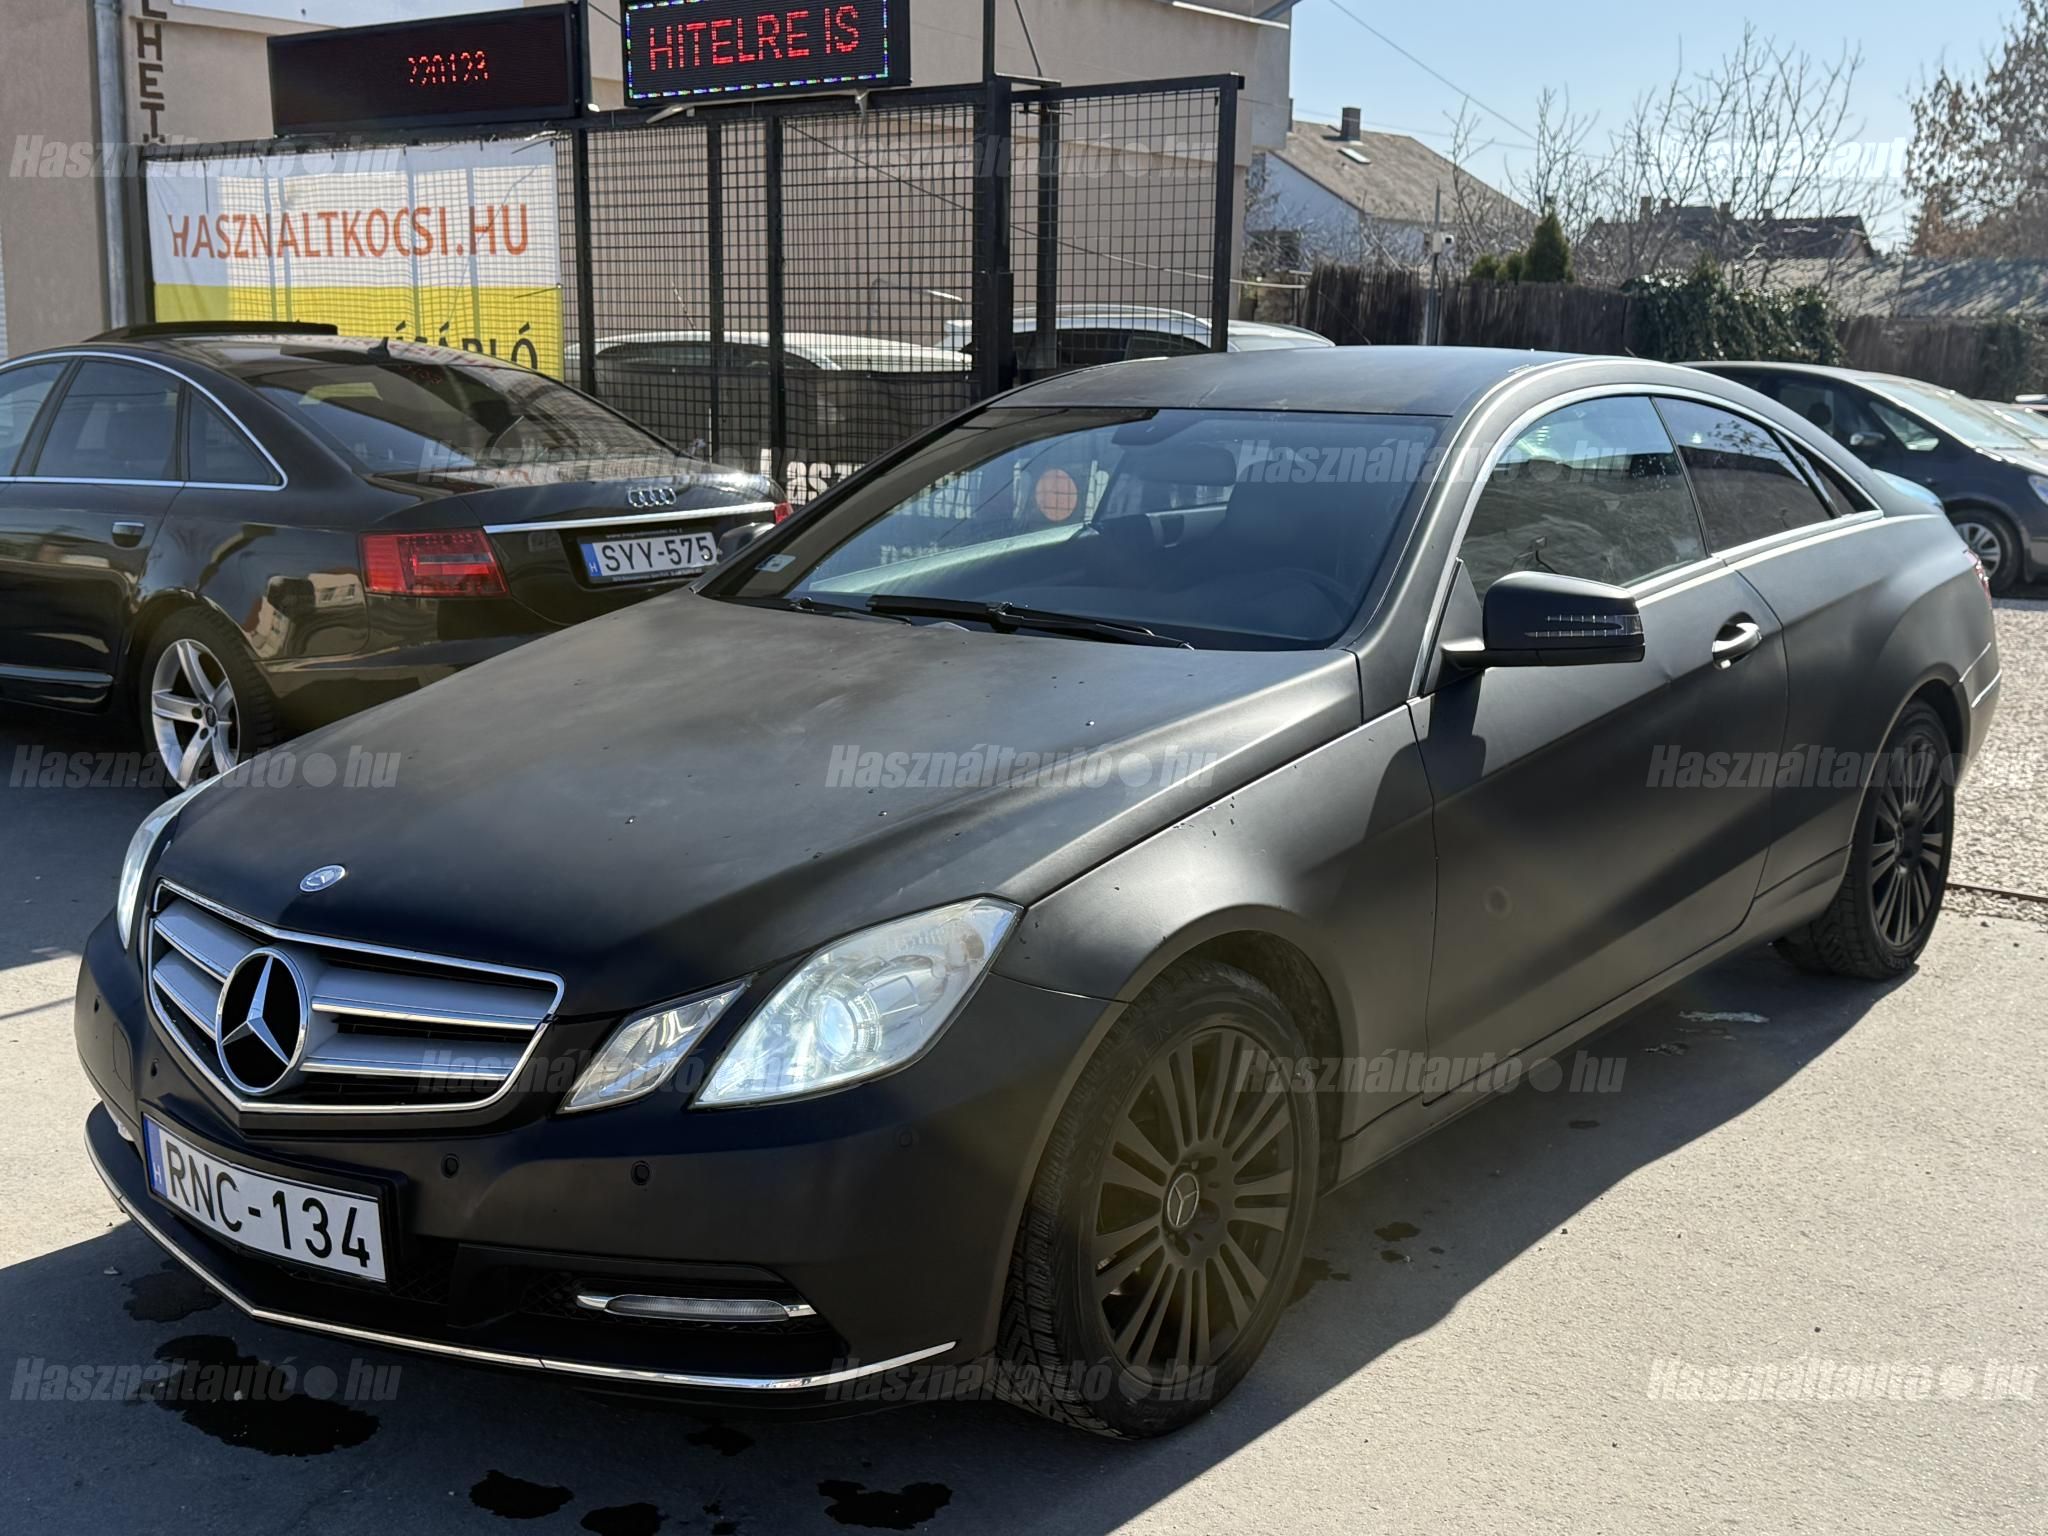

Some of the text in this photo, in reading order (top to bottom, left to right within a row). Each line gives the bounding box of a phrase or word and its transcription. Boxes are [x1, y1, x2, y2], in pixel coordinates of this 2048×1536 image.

[650, 5, 859, 70] HITELRE IS
[601, 536, 713, 571] SYY-575
[166, 1139, 371, 1268] RNC-134
